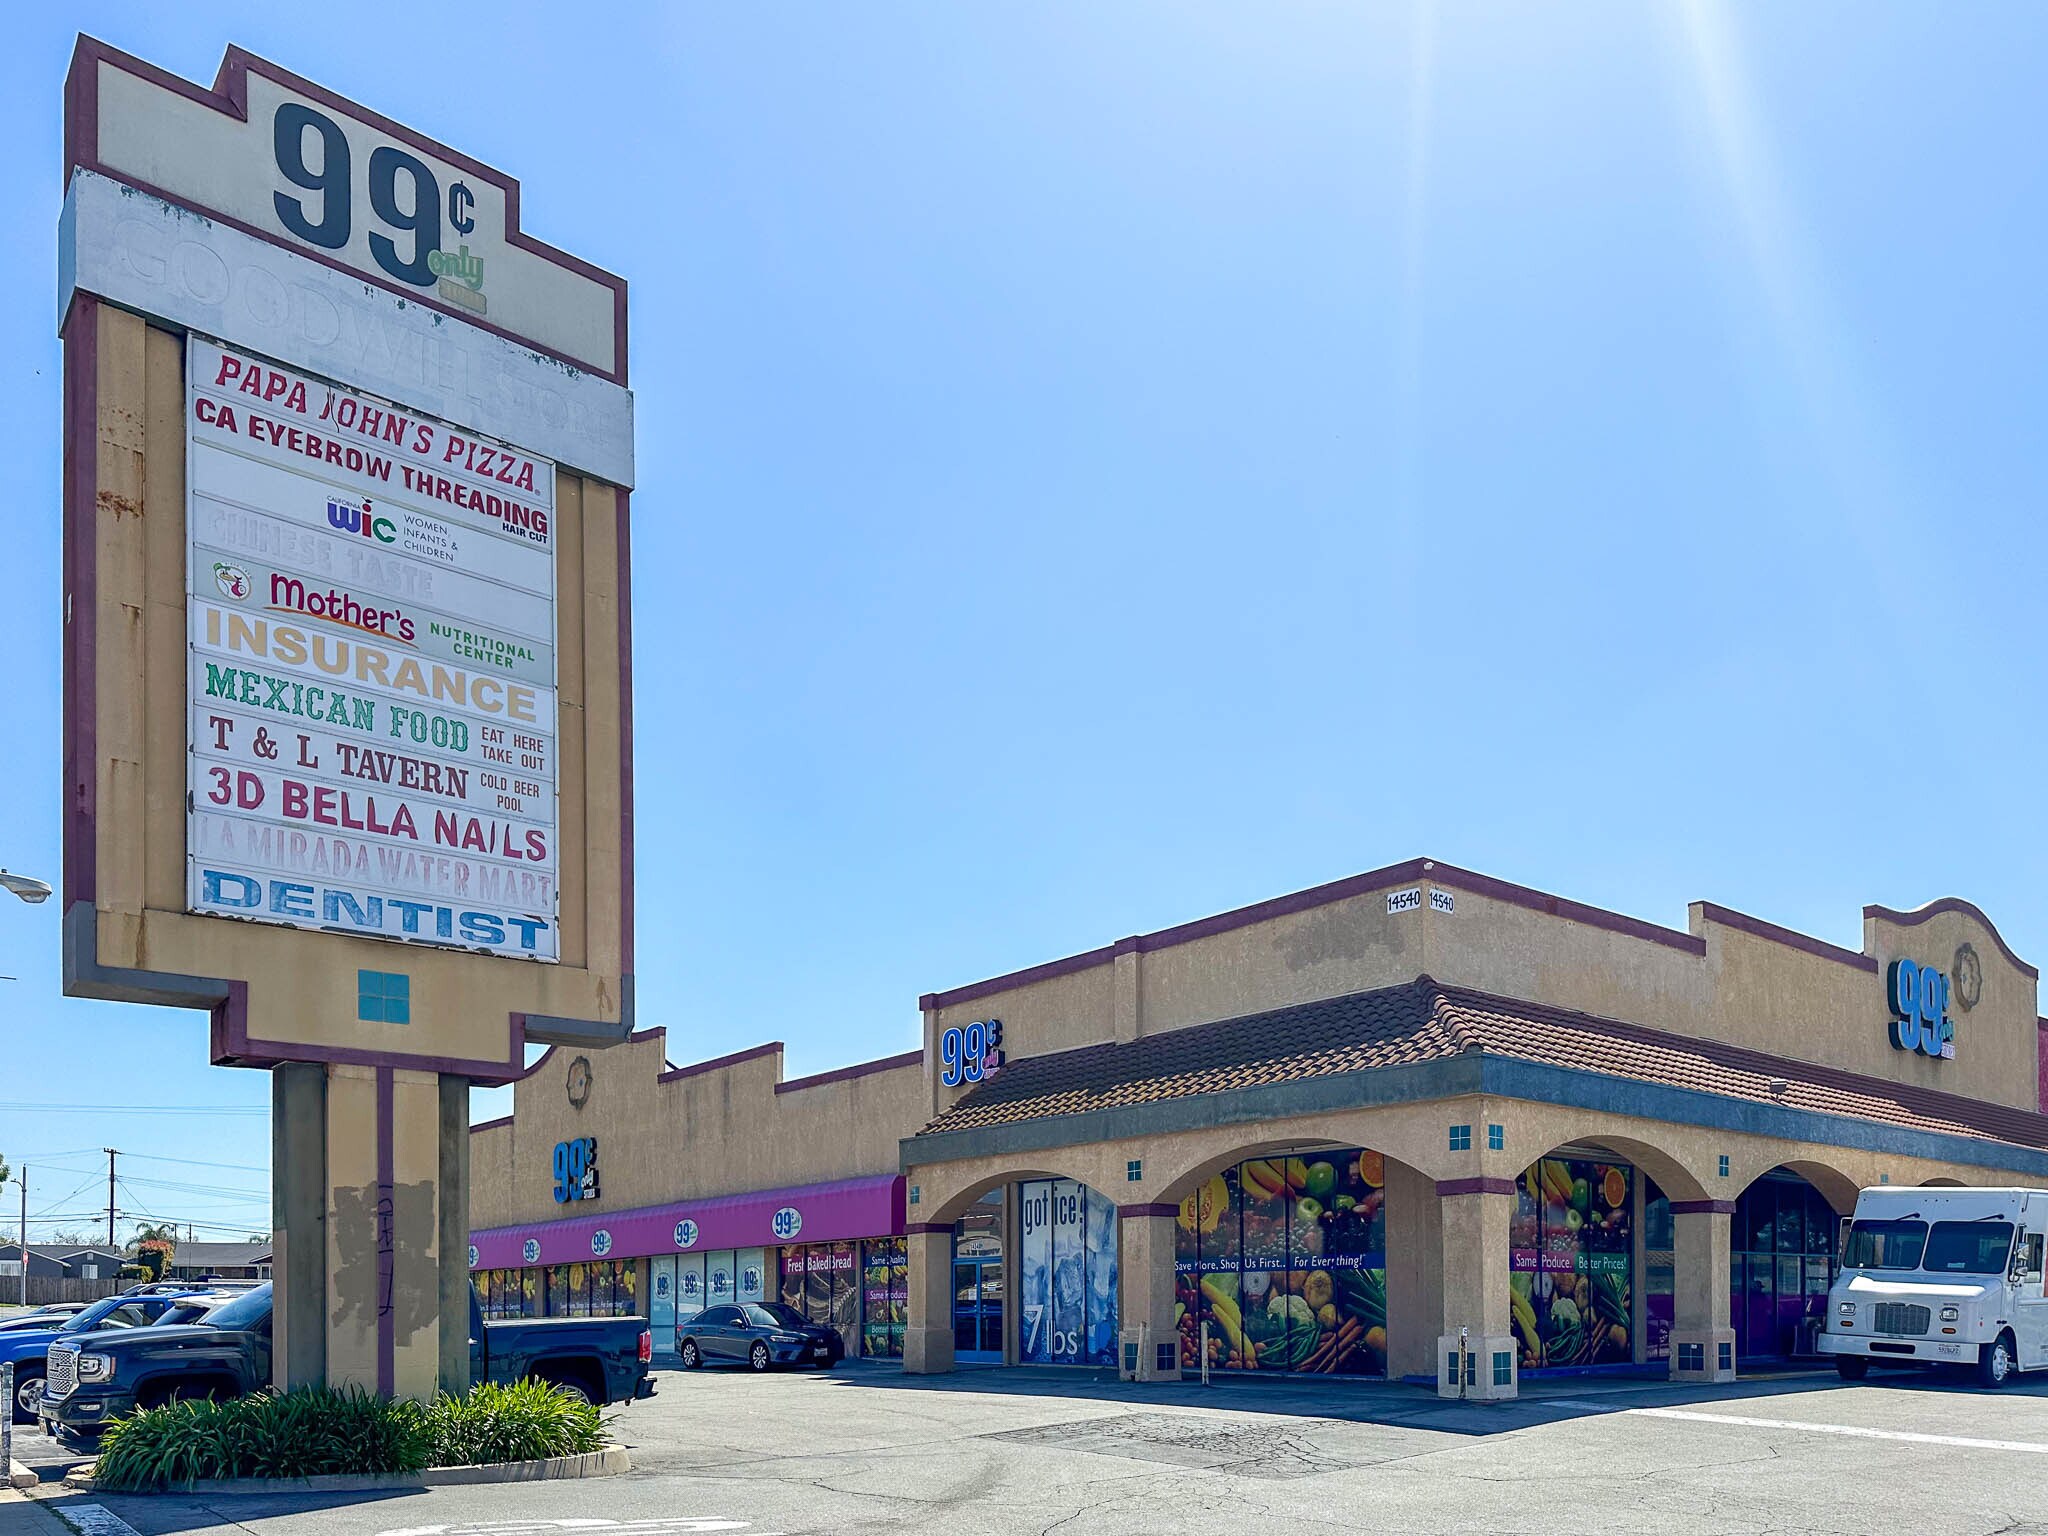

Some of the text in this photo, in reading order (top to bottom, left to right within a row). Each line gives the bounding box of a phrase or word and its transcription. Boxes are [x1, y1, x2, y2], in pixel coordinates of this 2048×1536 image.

[215, 354, 307, 413] PAPA
[318, 391, 434, 454] JOHN'S
[443, 435, 534, 492] PIZZA
[195, 398, 548, 535] CA EYEBROW THREADING
[326, 495, 362, 510] CALIFORNIA
[403, 527, 459, 551] INFANTS &
[502, 522, 548, 544] HAIR CUT
[403, 540, 455, 562] CHILDREN
[430, 622, 535, 662] NUTRITIONAL
[206, 608, 537, 723] INSURANCE
[453, 643, 514, 669] CENTER
[205, 662, 470, 752] MEXICAN FOOD
[481, 726, 544, 754] EAT HERE
[209, 715, 469, 800] T & L TAVERN
[481, 744, 545, 771] TAKE OUT
[480, 772, 540, 799] COLD BEER
[208, 767, 547, 861] 3D BELLA NAILS
[497, 795, 524, 813] POOL
[248, 823, 373, 881] MIRADA
[378, 847, 470, 898] WATER
[479, 864, 551, 907] MART
[202, 869, 549, 950] DENTIST
[1388, 890, 1421, 911] 14540
[1429, 891, 1454, 912] 14540
[1025, 1189, 1049, 1236] got
[807, 1255, 828, 1271] Baked
[871, 1256, 886, 1265] Same
[1174, 1260, 1192, 1271] Save
[1244, 1258, 1256, 1269] Us
[1294, 1256, 1308, 1267] For
[1516, 1253, 1572, 1269] Same Poduce.
[1024, 1304, 1078, 1355] 7 lbs
